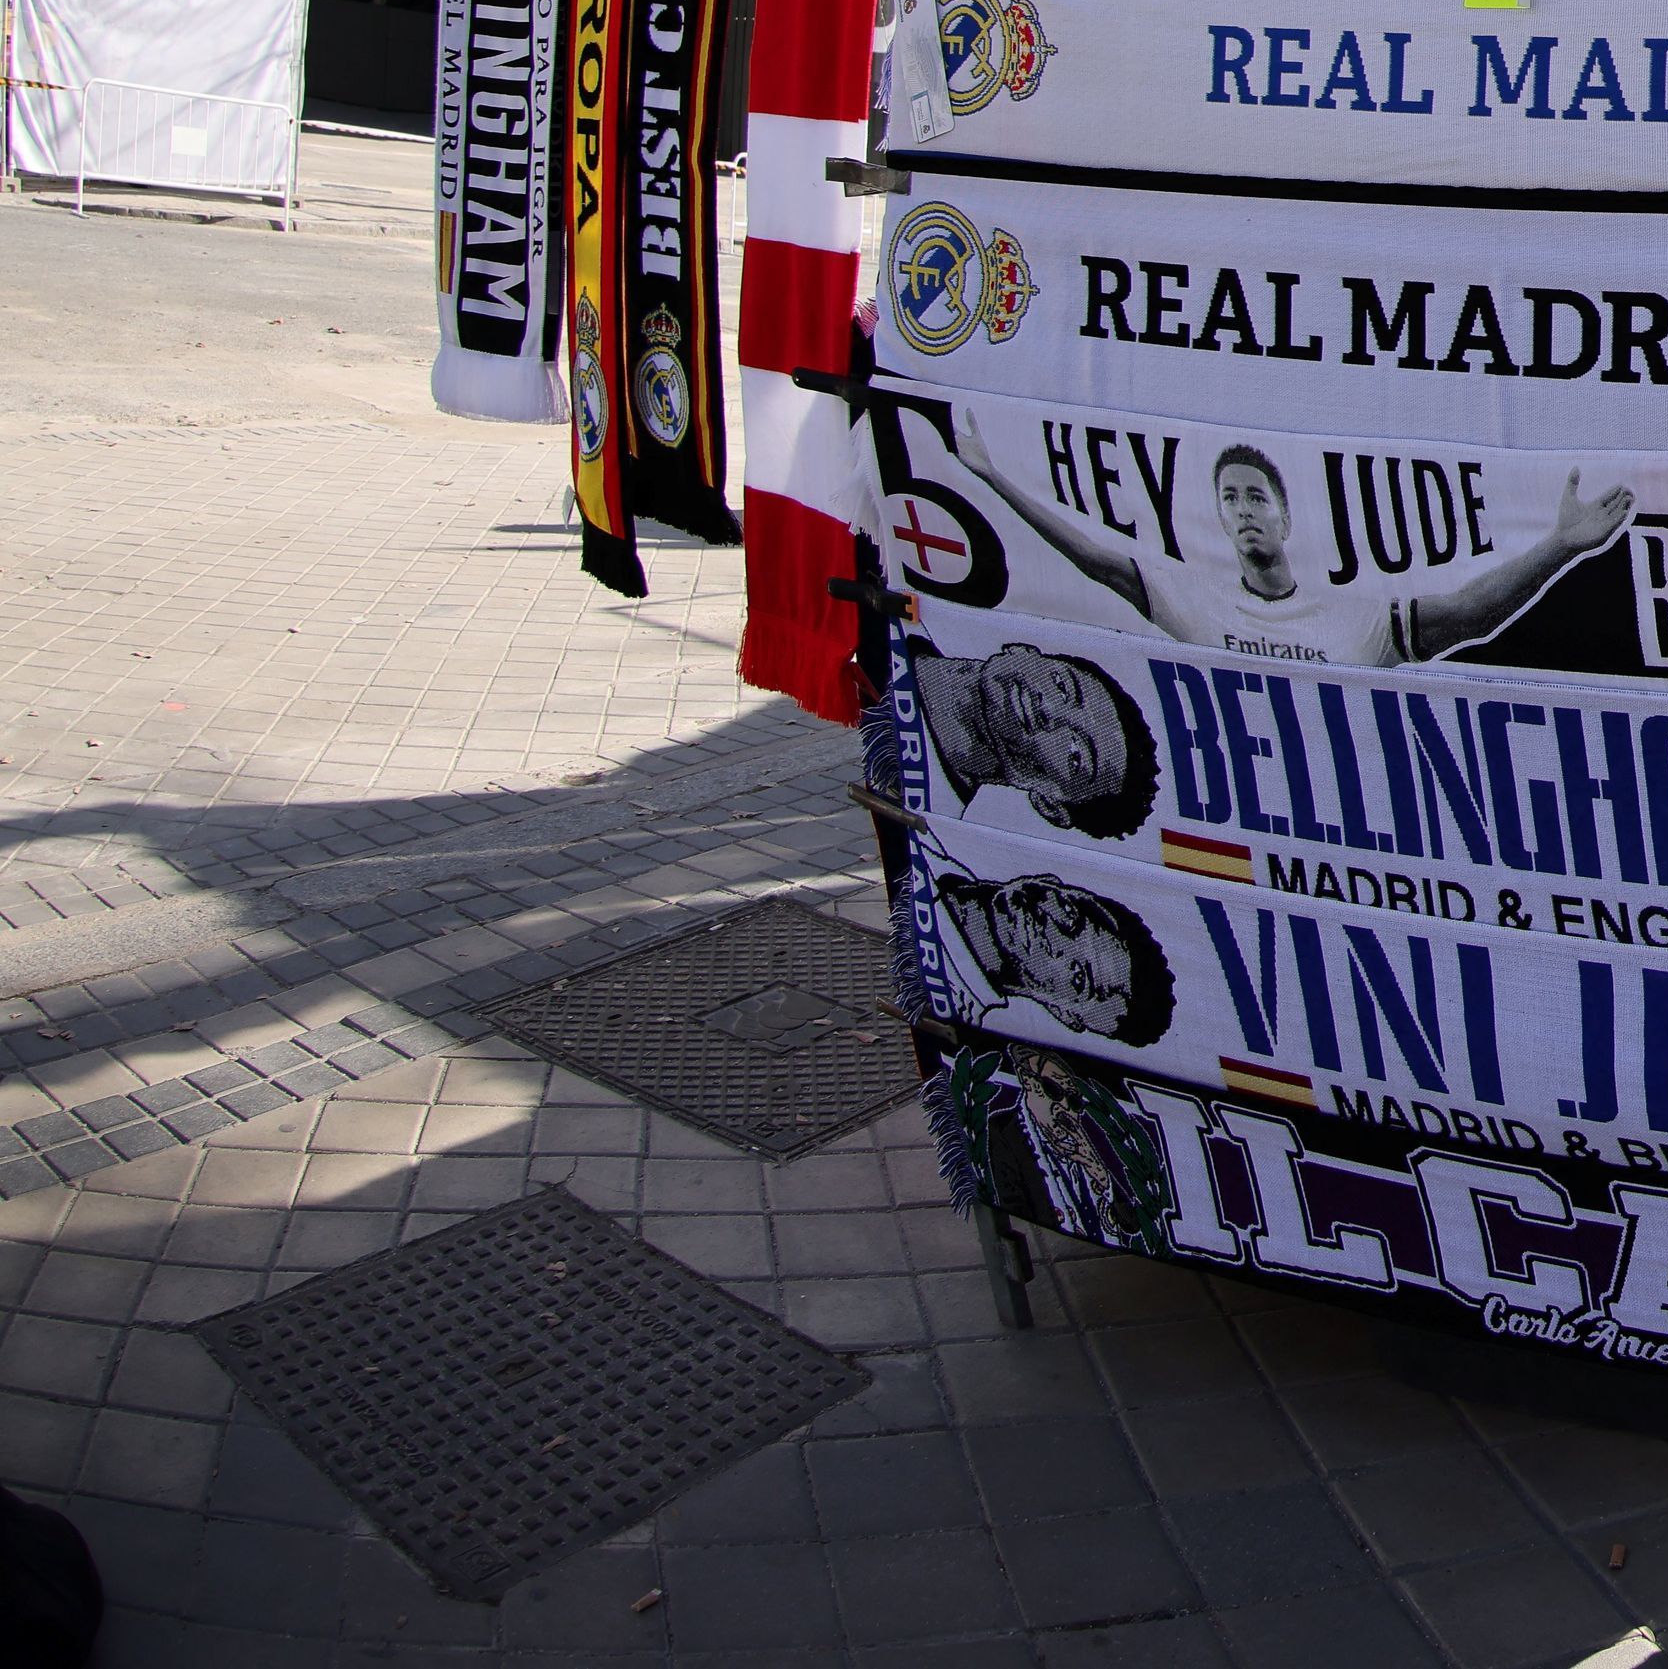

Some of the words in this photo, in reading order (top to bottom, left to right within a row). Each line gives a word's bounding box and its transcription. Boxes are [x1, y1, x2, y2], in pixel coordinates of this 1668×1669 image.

[439, 45, 464, 202] MADRID
[532, 31, 550, 130] PARA
[1206, 25, 1435, 115] REAL
[528, 140, 549, 259] JUGAR
[640, 70, 685, 283] BEST
[1078, 254, 1324, 363] REAL
[1042, 419, 1182, 563] HEY
[1322, 450, 1494, 587] JUDE
[1195, 896, 1505, 1106] VINI
[1124, 1077, 1398, 1294] IL
